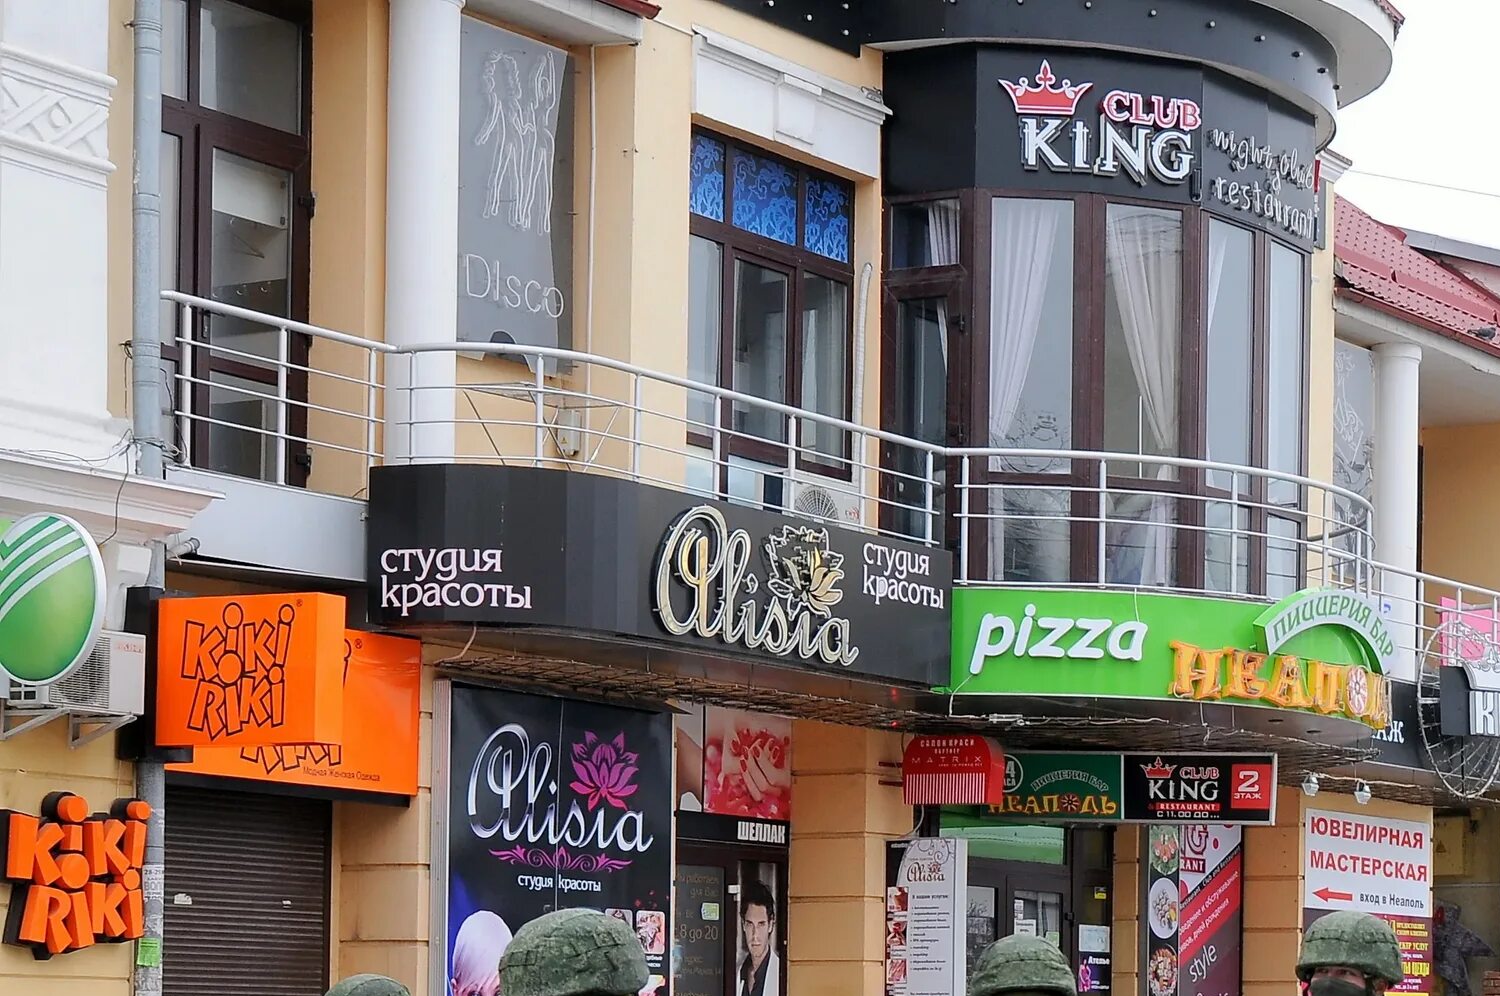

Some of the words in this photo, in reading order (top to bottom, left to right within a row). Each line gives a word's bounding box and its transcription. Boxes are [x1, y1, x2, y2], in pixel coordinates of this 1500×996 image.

[1103, 90, 1201, 131] CLUB
[1215, 176, 1313, 239] restaurant
[466, 253, 564, 318] DISCO
[380, 548, 503, 582] студия
[862, 542, 931, 580] студия
[380, 574, 533, 617] красоты
[862, 565, 945, 609] красоты
[969, 603, 1148, 675] pizza
[1272, 594, 1372, 644] ПИЦЦЕРИЯ
[1369, 616, 1394, 657] БАР
[911, 755, 982, 764] MATRIX
[1180, 766, 1220, 780] CLUB
[1030, 769, 1090, 792] ПИЦЦЕРИЯ
[1088, 775, 1110, 792] БАР
[1148, 779, 1219, 801] KING
[1237, 770, 1260, 792] 2
[1159, 802, 1217, 811] RESTAURANT
[1233, 792, 1262, 800] ЭТАЖ
[737, 820, 786, 844] ШЕЛЛАК
[1310, 816, 1423, 850] ЮВЕЛИРНАЯ
[1180, 857, 1205, 872] RANT
[1310, 850, 1428, 882] МАСТЕРСКАЯ
[517, 873, 554, 891] студия
[557, 874, 602, 893] красоты
[1359, 892, 1381, 906] вход
[1381, 895, 1387, 905] в
[1388, 893, 1425, 909] Неаполь
[704, 925, 719, 940] 20
[1188, 944, 1217, 983] style
